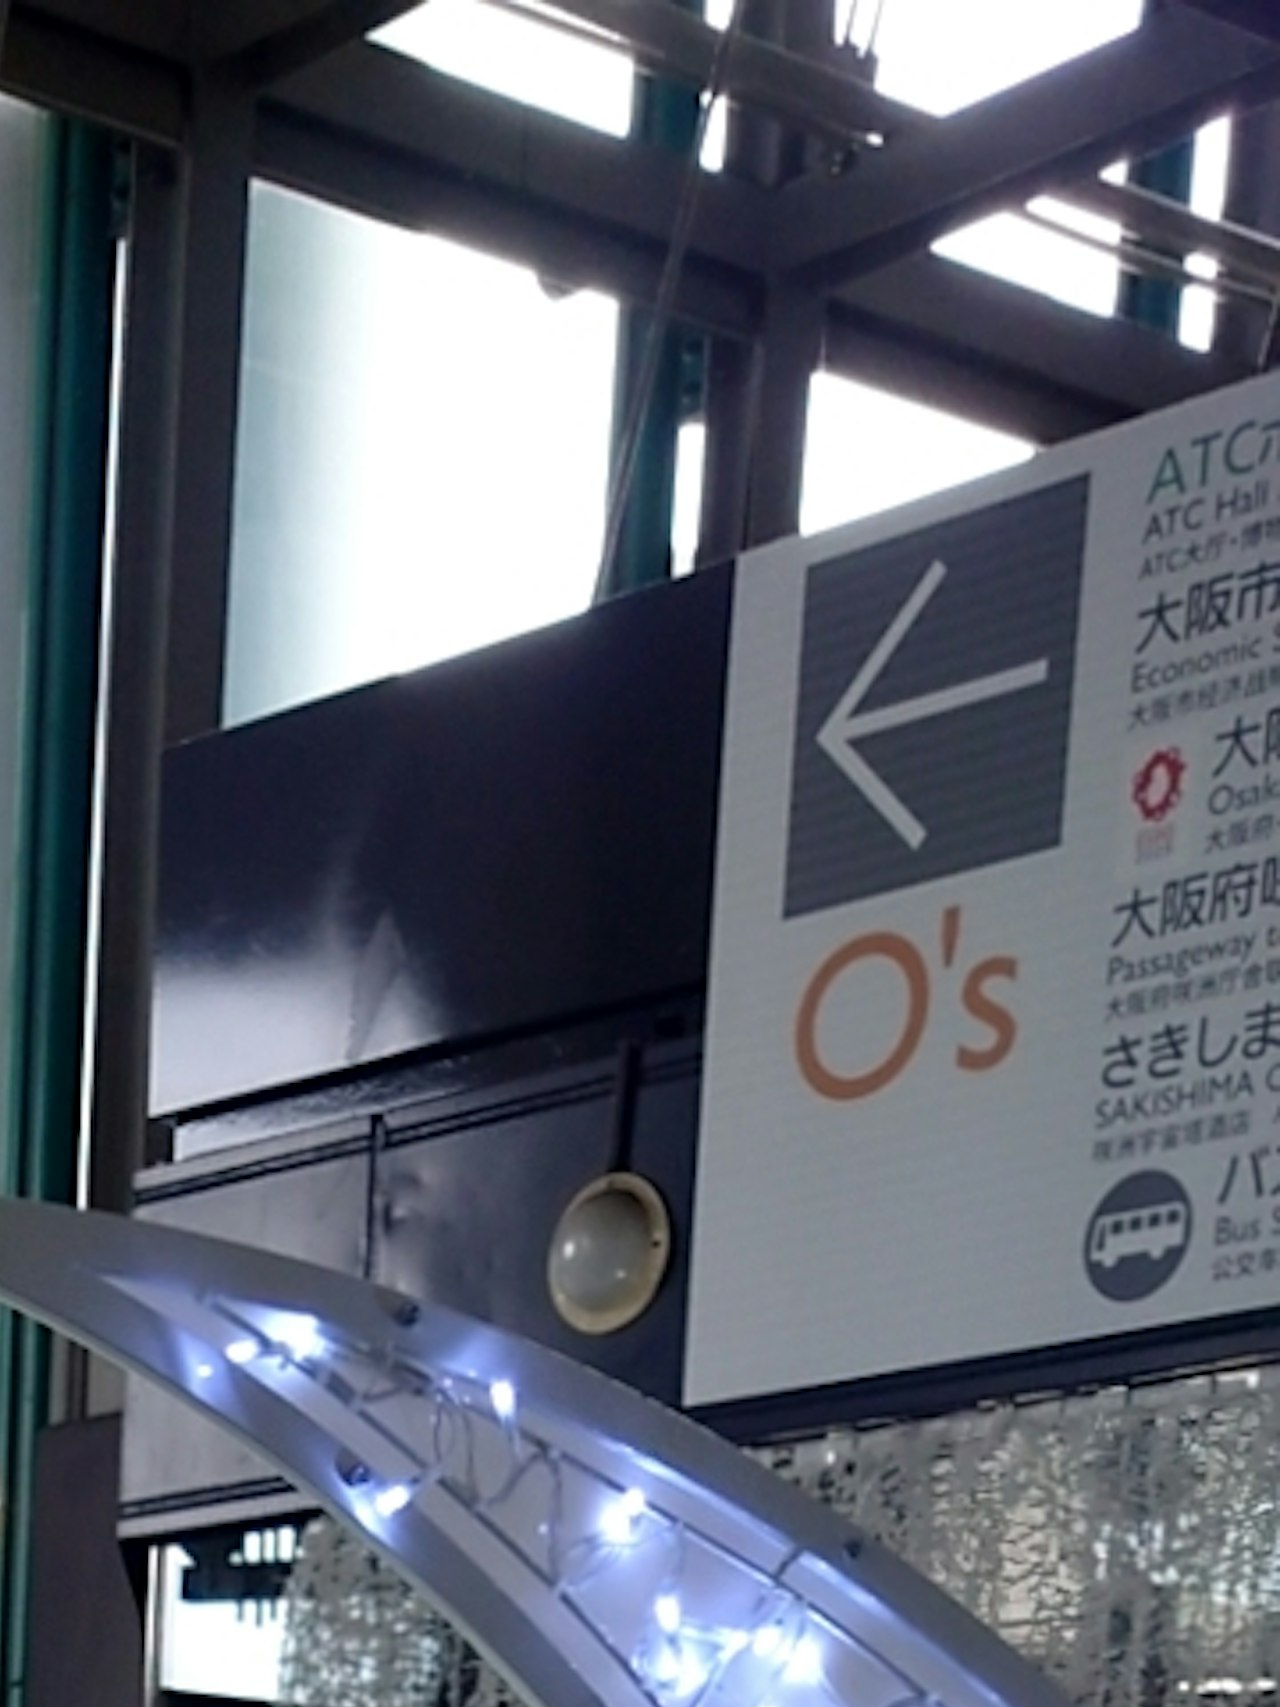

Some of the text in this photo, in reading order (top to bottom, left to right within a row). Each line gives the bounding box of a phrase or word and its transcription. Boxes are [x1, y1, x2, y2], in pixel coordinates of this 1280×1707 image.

[1142, 480, 1269, 546] ATC Hall
[1131, 634, 1263, 693] Economic
[1106, 934, 1256, 986] Passageway
[795, 904, 1020, 1103] O's
[1095, 1070, 1254, 1130] SAKISHIMA
[1218, 1145, 1280, 1204] バ
[1215, 1217, 1261, 1246] Bus
